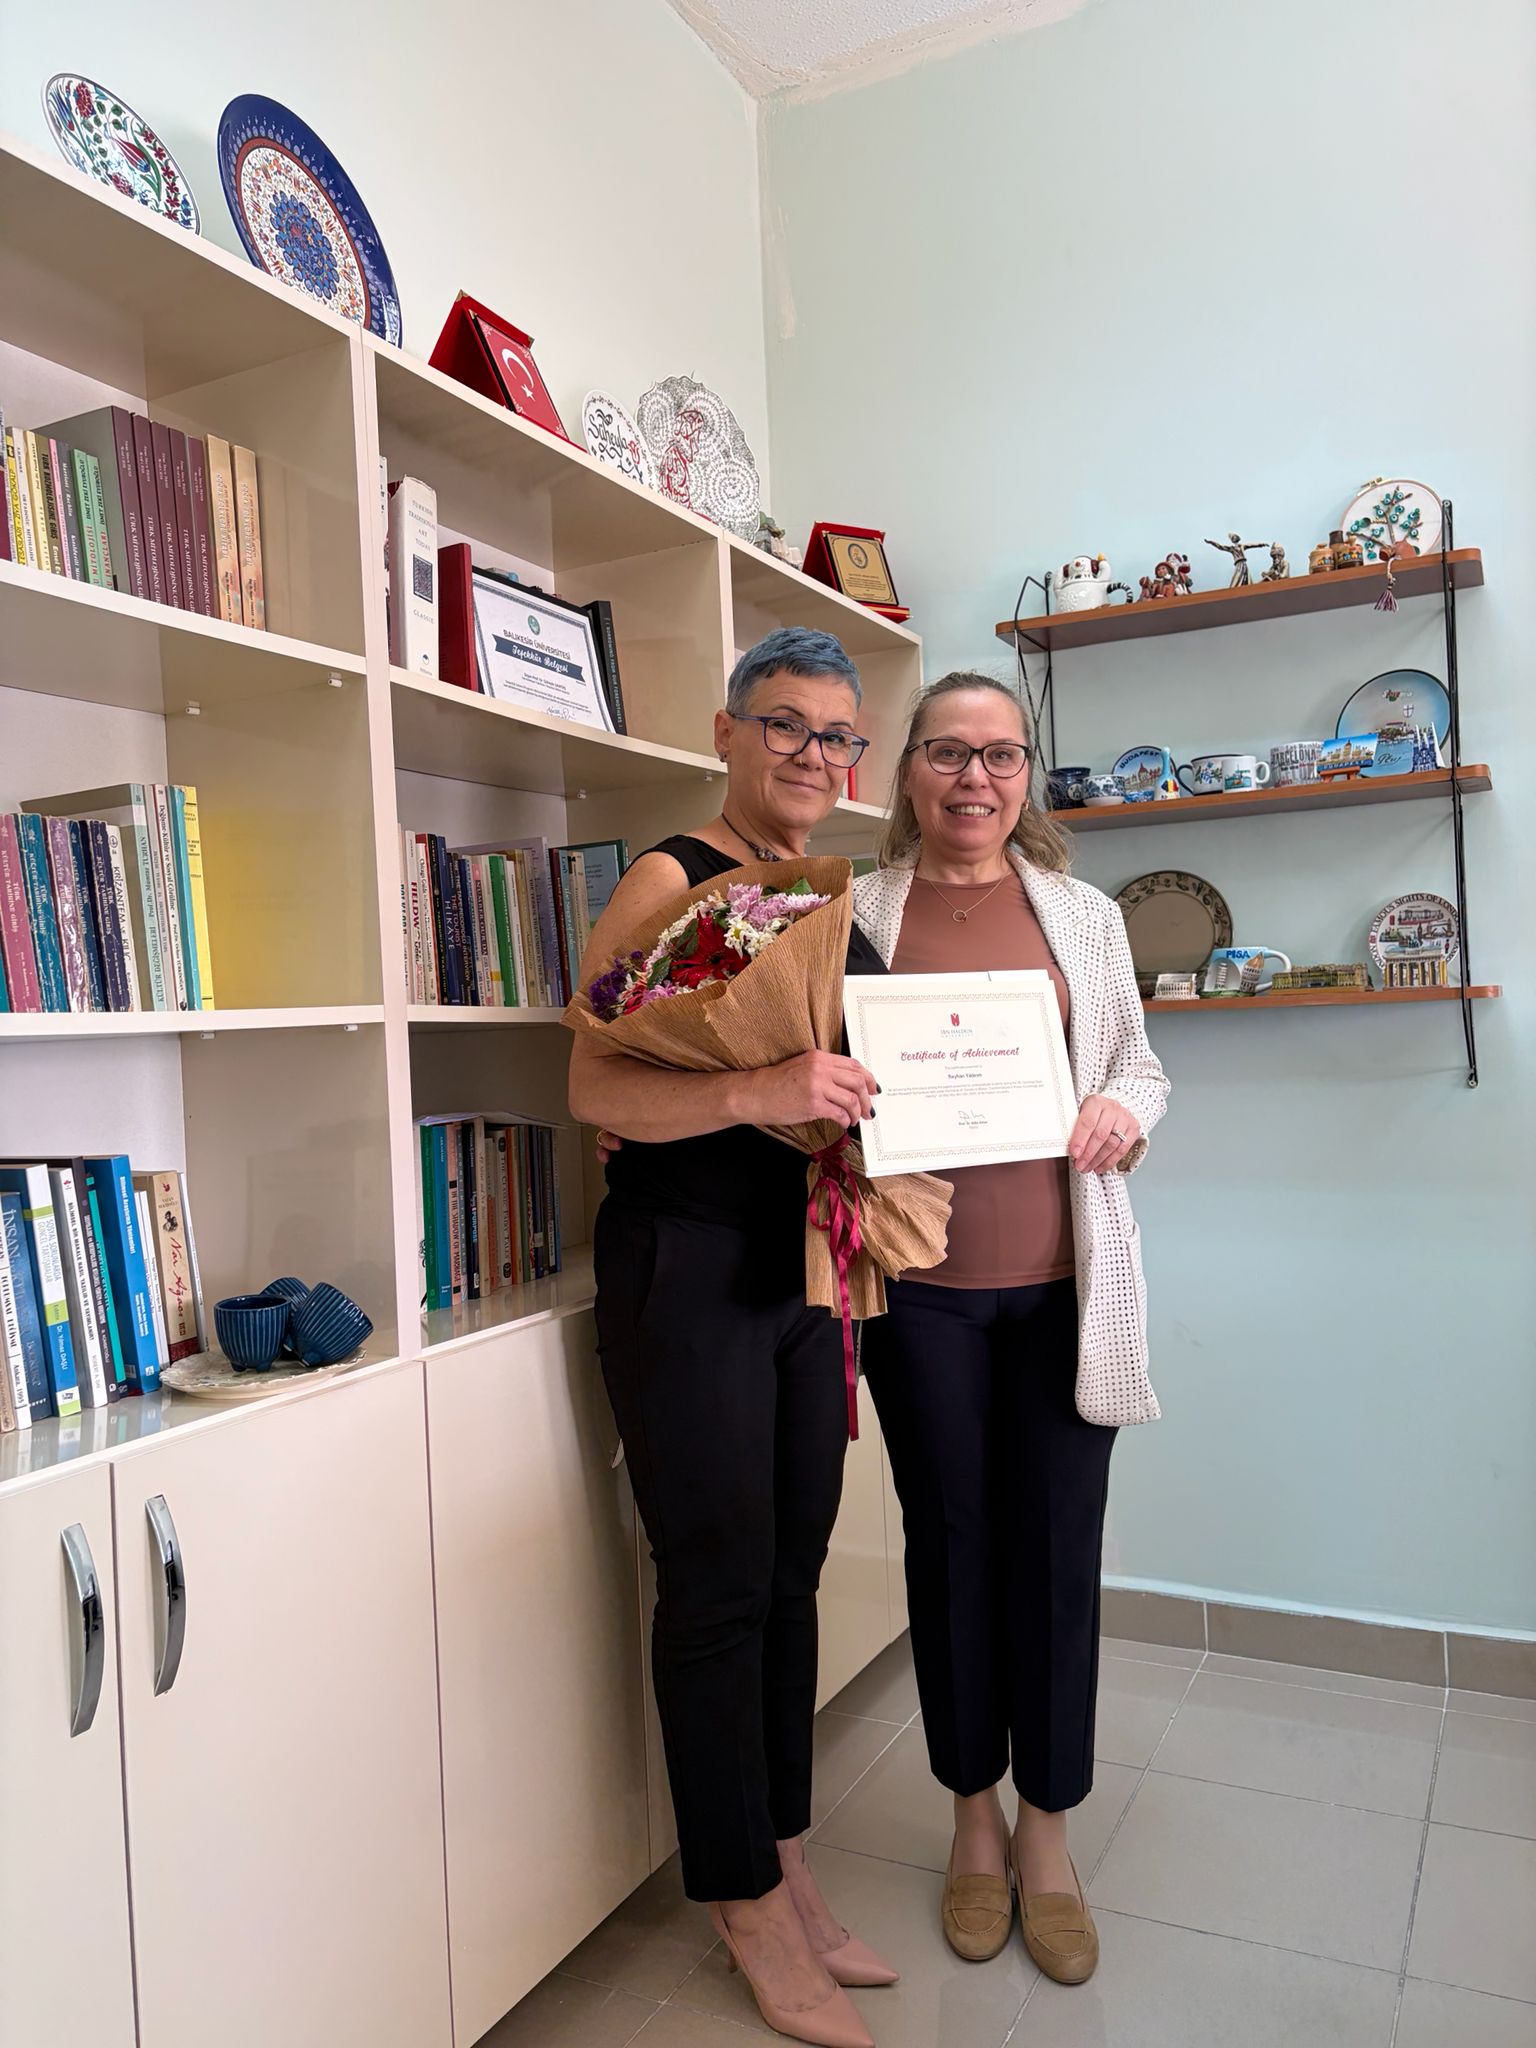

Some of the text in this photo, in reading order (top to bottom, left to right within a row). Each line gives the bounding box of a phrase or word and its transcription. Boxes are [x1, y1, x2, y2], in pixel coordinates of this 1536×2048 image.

[129, 509, 137, 533] TÜRK
[147, 514, 155, 537] TÜRK
[182, 528, 190, 550] TÜRK
[199, 533, 207, 556] TÜRK
[52, 545, 60, 565] Emel
[503, 629, 534, 646] BALIKESİR
[164, 862, 173, 882] Sosyal
[112, 866, 128, 923] KRİZANTEM
[410, 881, 419, 930] FIELDW
[475, 880, 483, 917] NUMBER
[452, 912, 461, 947] TOURIST
[462, 945, 470, 980] INTERVIEW
[1226, 950, 1251, 959] PISA
[154, 973, 163, 1001] KÜLTÜR
[900, 1046, 1020, 1063] Certificate of Achievement
[67, 1202, 77, 1227] BİLİMSEL
[118, 1175, 136, 1254] Bilimsel Araştırma Yöntemleri
[2, 1208, 22, 1259] İNSAN
[71, 1227, 79, 1238] BİR
[45, 1218, 61, 1281] SOSYAL SORUNLARDA
[73, 1238, 81, 1260] MAKALE
[453, 1241, 459, 1249] OF
[79, 1278, 88, 1299] YAZILIR
[166, 1236, 190, 1319] Nar Ağacı
[57, 1334, 66, 1352] Yılmaz
